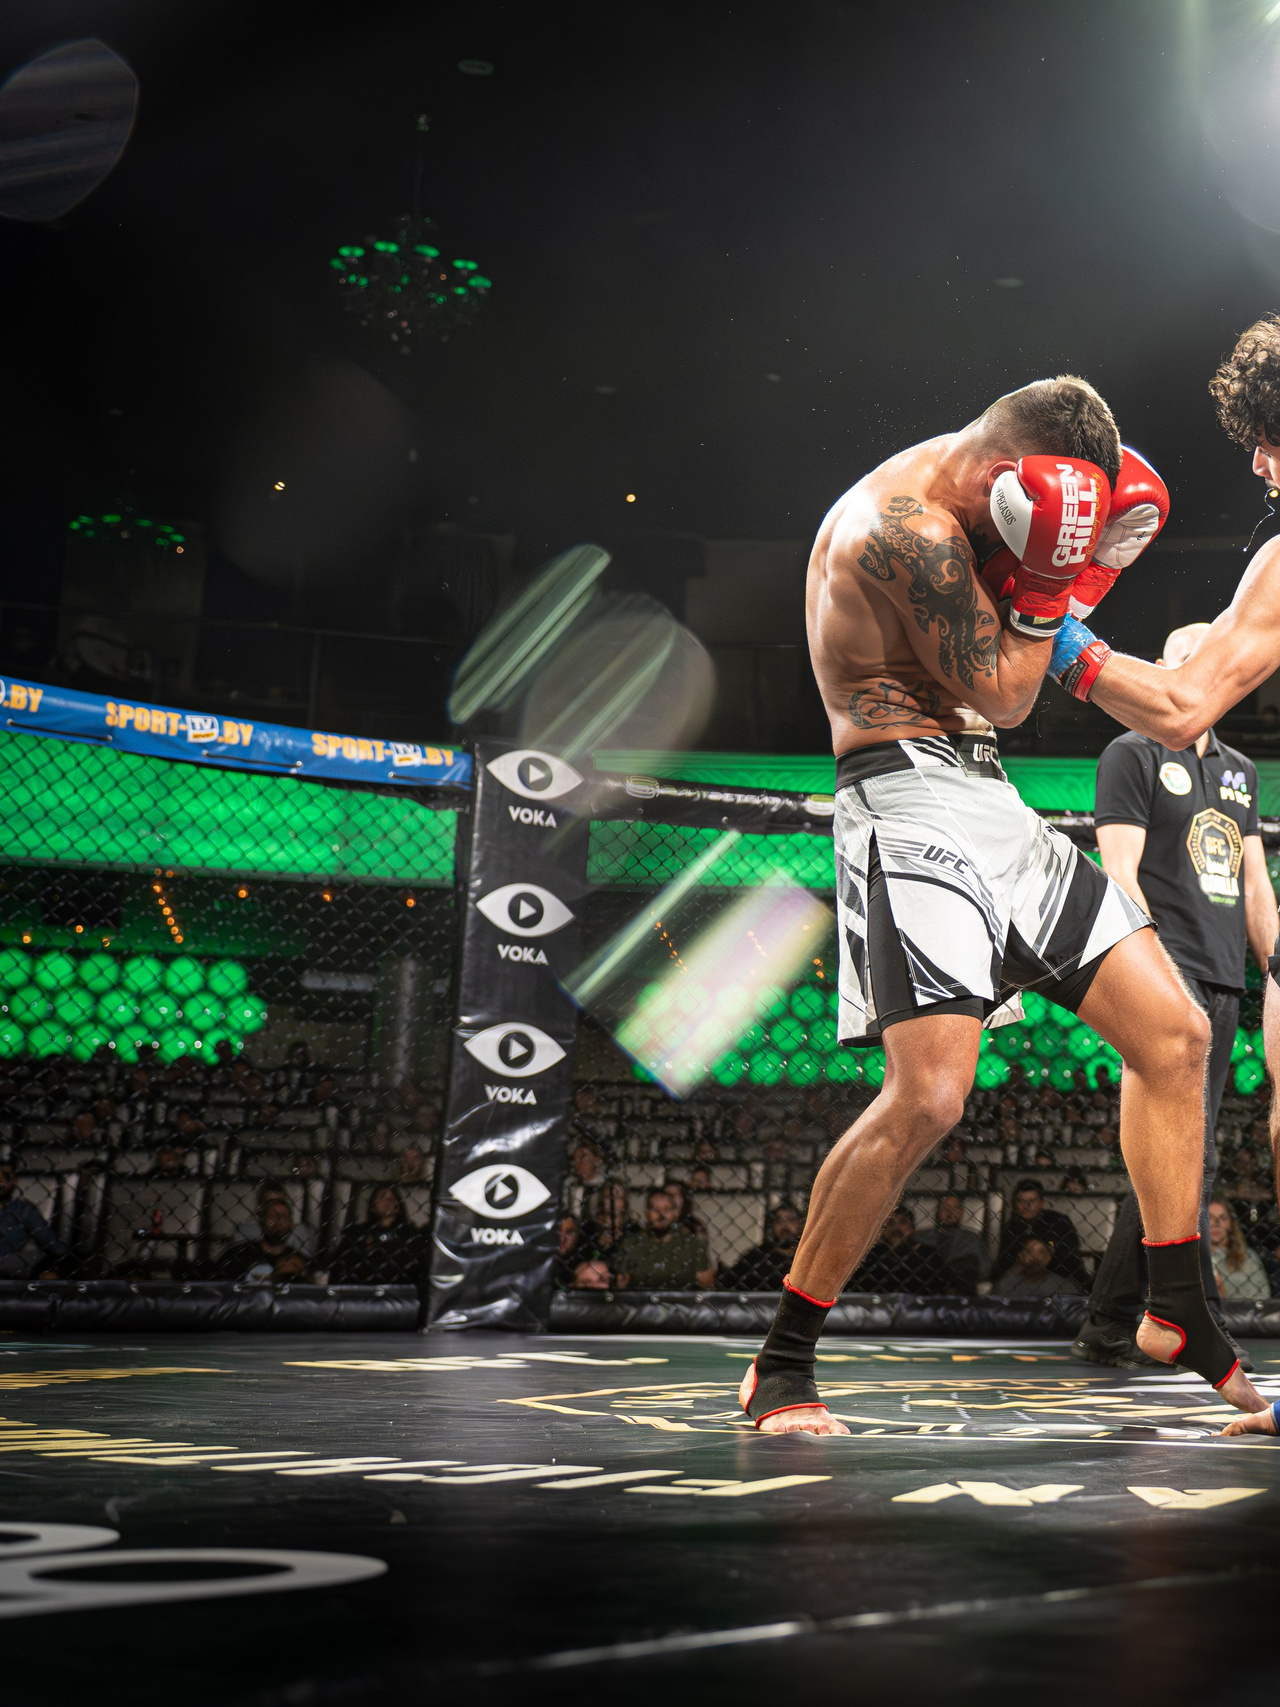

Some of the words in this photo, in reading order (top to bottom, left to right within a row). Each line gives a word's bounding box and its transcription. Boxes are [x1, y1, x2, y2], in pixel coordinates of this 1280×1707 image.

[996, 491, 1017, 526] PEGASUS
[1052, 463, 1079, 567] GREEN
[1068, 478, 1098, 565] HILL
[972, 743, 998, 762] UFC
[508, 805, 557, 829] VOKA
[922, 843, 969, 875] UFC
[497, 943, 549, 966] VOKA
[485, 1083, 537, 1106] VOKA
[471, 1227, 525, 1246] VOKA
